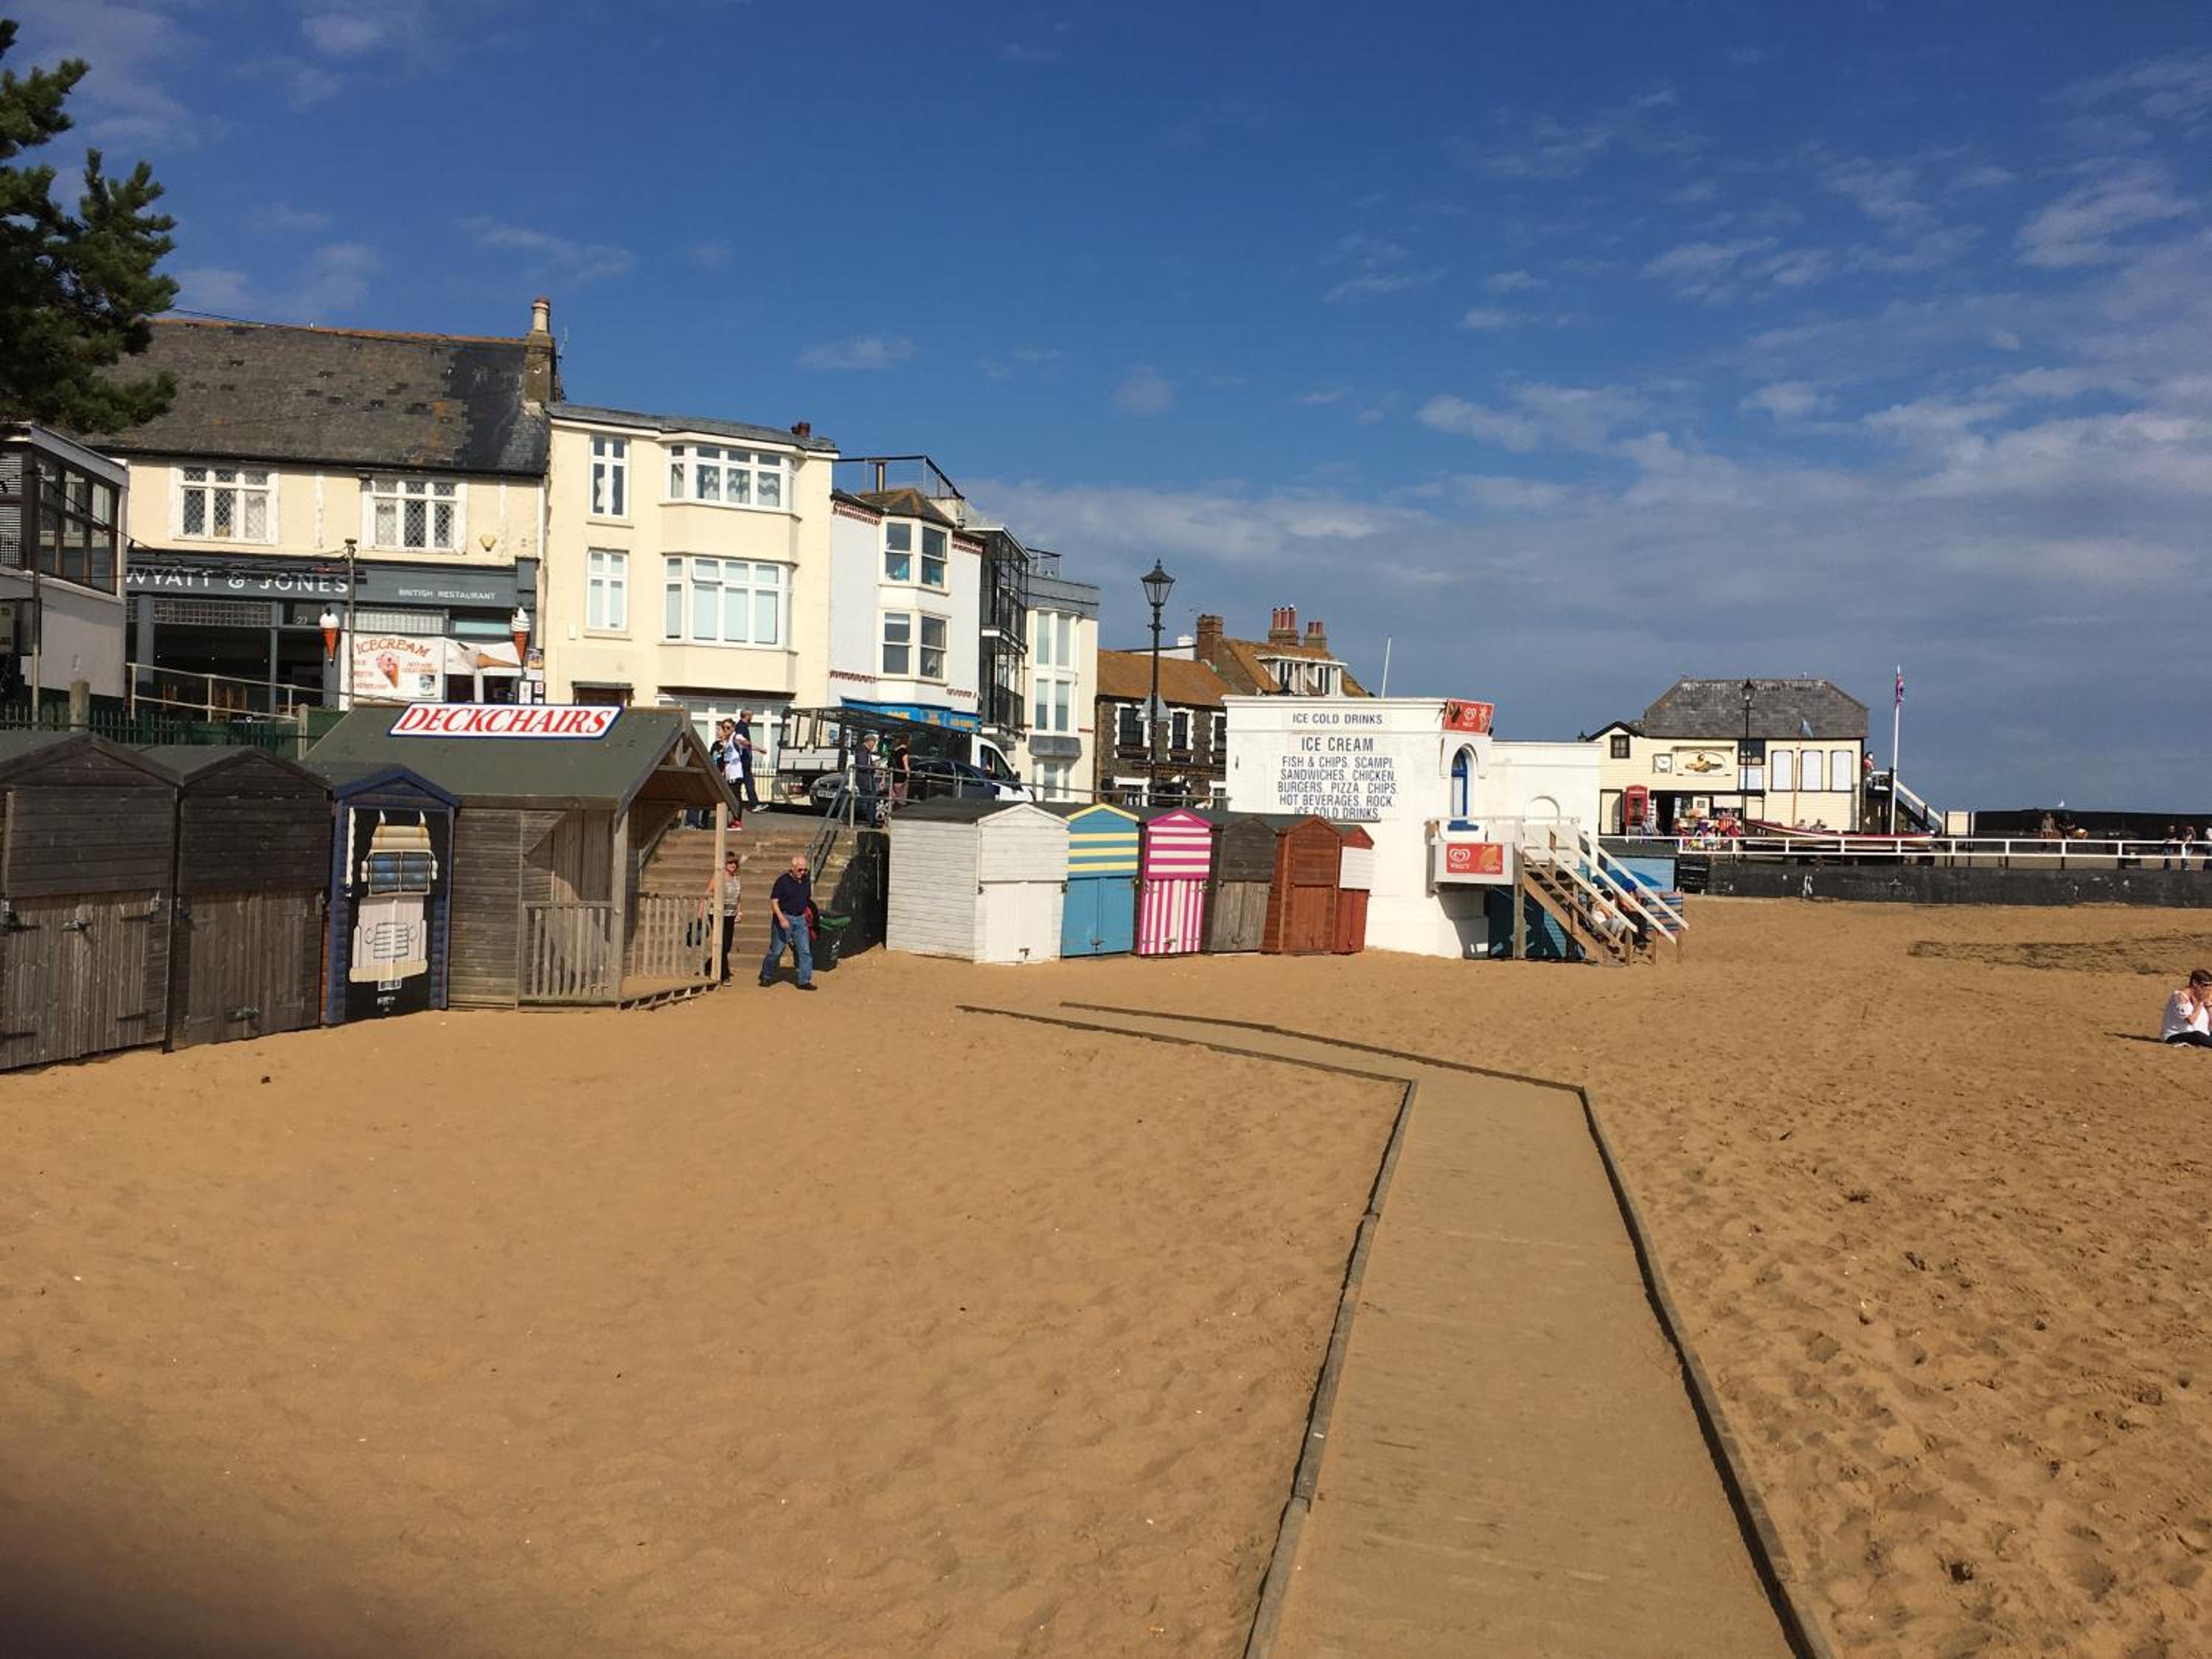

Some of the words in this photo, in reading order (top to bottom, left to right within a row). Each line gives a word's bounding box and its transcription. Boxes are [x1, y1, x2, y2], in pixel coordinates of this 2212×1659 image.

[258, 572, 349, 593] JONES
[399, 589, 433, 598] BRITISH
[437, 591, 496, 600] RESTAURANT
[355, 638, 432, 658] ICECREAM
[398, 706, 613, 734] DECKCHAIRS
[1293, 712, 1309, 724] ICE
[1312, 713, 1340, 724] COLD
[1344, 714, 1383, 725] DRINKS
[1301, 737, 1322, 751] ICE
[1328, 737, 1374, 752] CREAM
[1282, 756, 1304, 768] FISH
[1307, 756, 1315, 768] &
[1279, 793, 1298, 806] HOT
[1313, 807, 1338, 819] COLD
[1343, 807, 1378, 819] DRINKS
